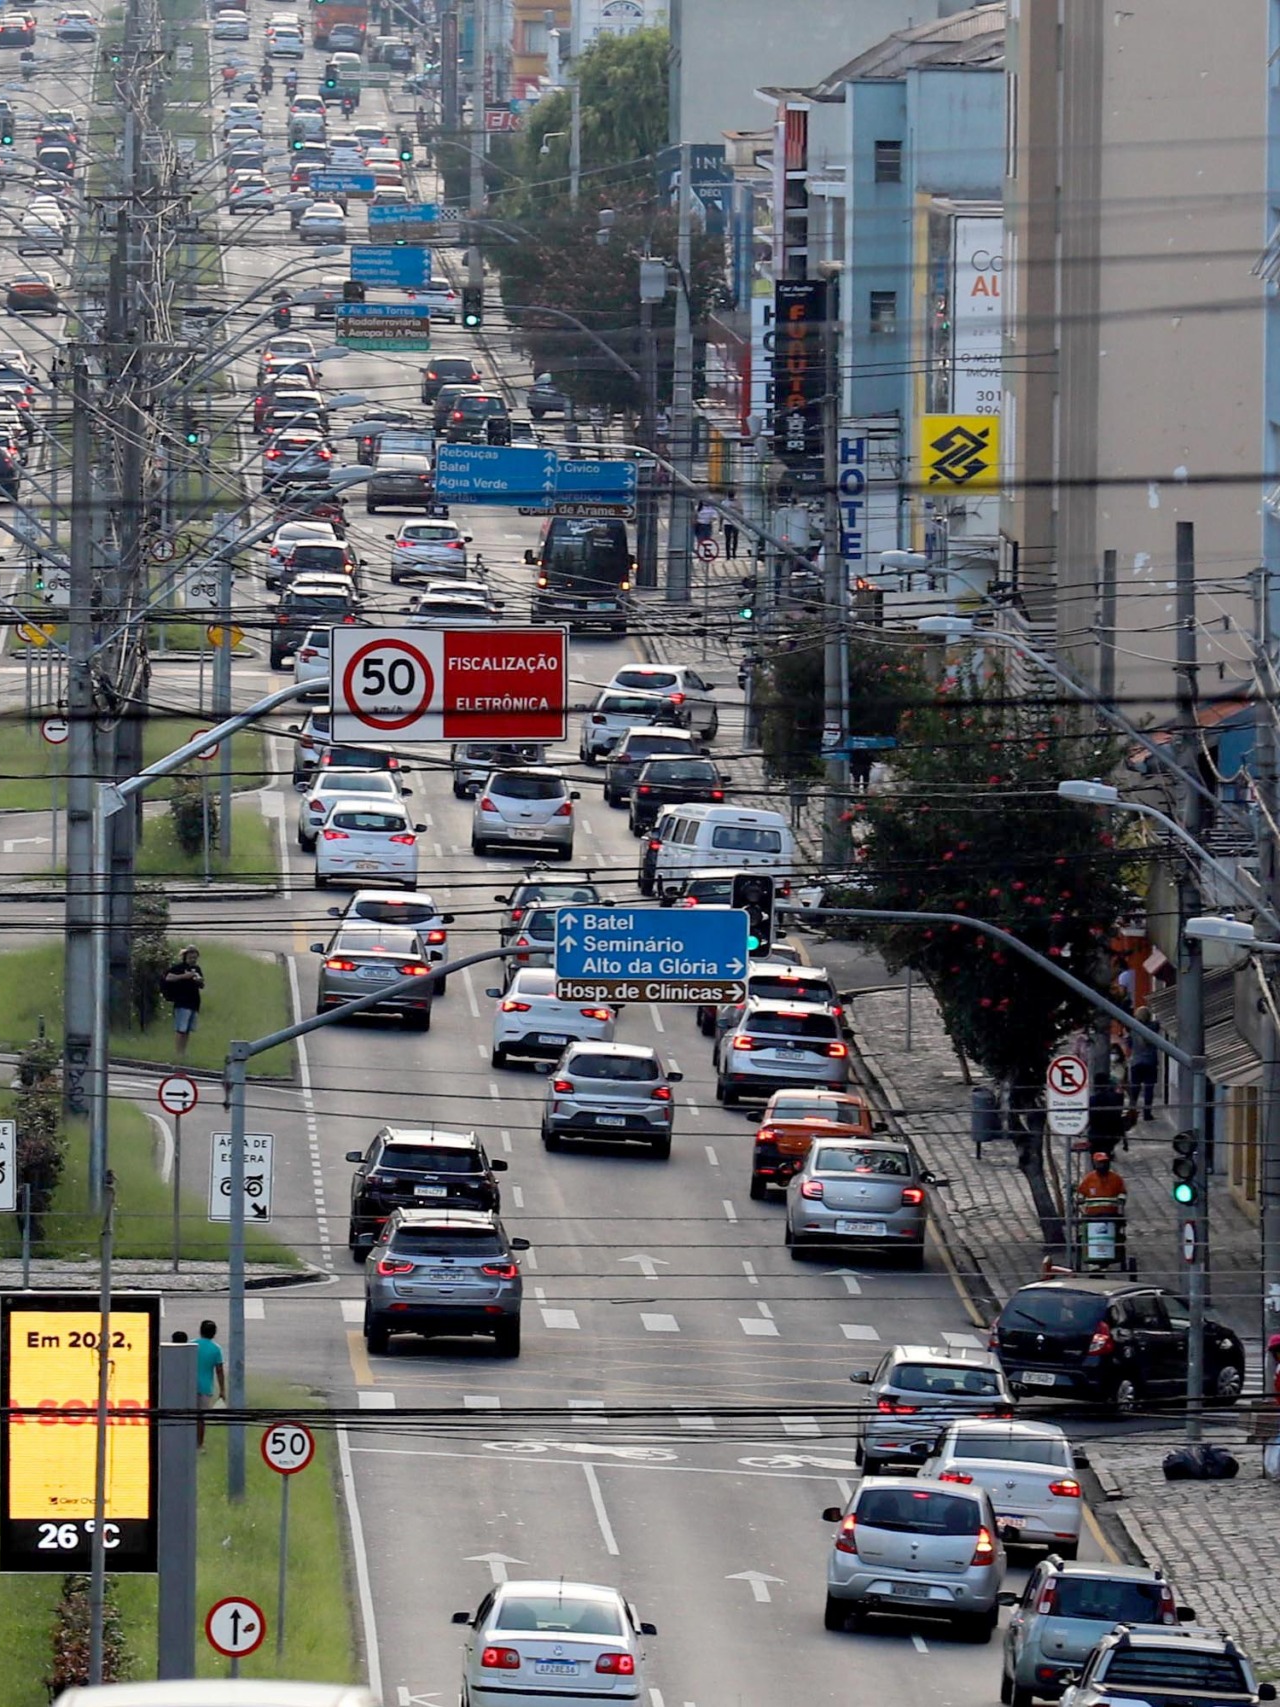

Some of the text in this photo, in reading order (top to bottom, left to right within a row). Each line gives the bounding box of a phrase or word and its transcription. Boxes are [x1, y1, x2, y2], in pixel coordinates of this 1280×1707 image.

[439, 447, 499, 460] Rebouças
[439, 461, 469, 472] Batel
[474, 477, 508, 490] Verde
[562, 505, 574, 515] de
[576, 506, 616, 516] Arame
[448, 653, 558, 673] FISCALIZAÇÃO
[362, 658, 416, 696] 50
[456, 693, 549, 711] ELETRÔNICA
[583, 914, 634, 930] Batel
[583, 936, 684, 953] Seminário
[582, 957, 718, 975] Alto da Glória
[645, 983, 723, 1001] Clínicas
[254, 1139, 268, 1148] DE
[27, 1332, 132, 1351] Em 202,
[271, 1433, 306, 1455] 50
[37, 1523, 79, 1549] 26
